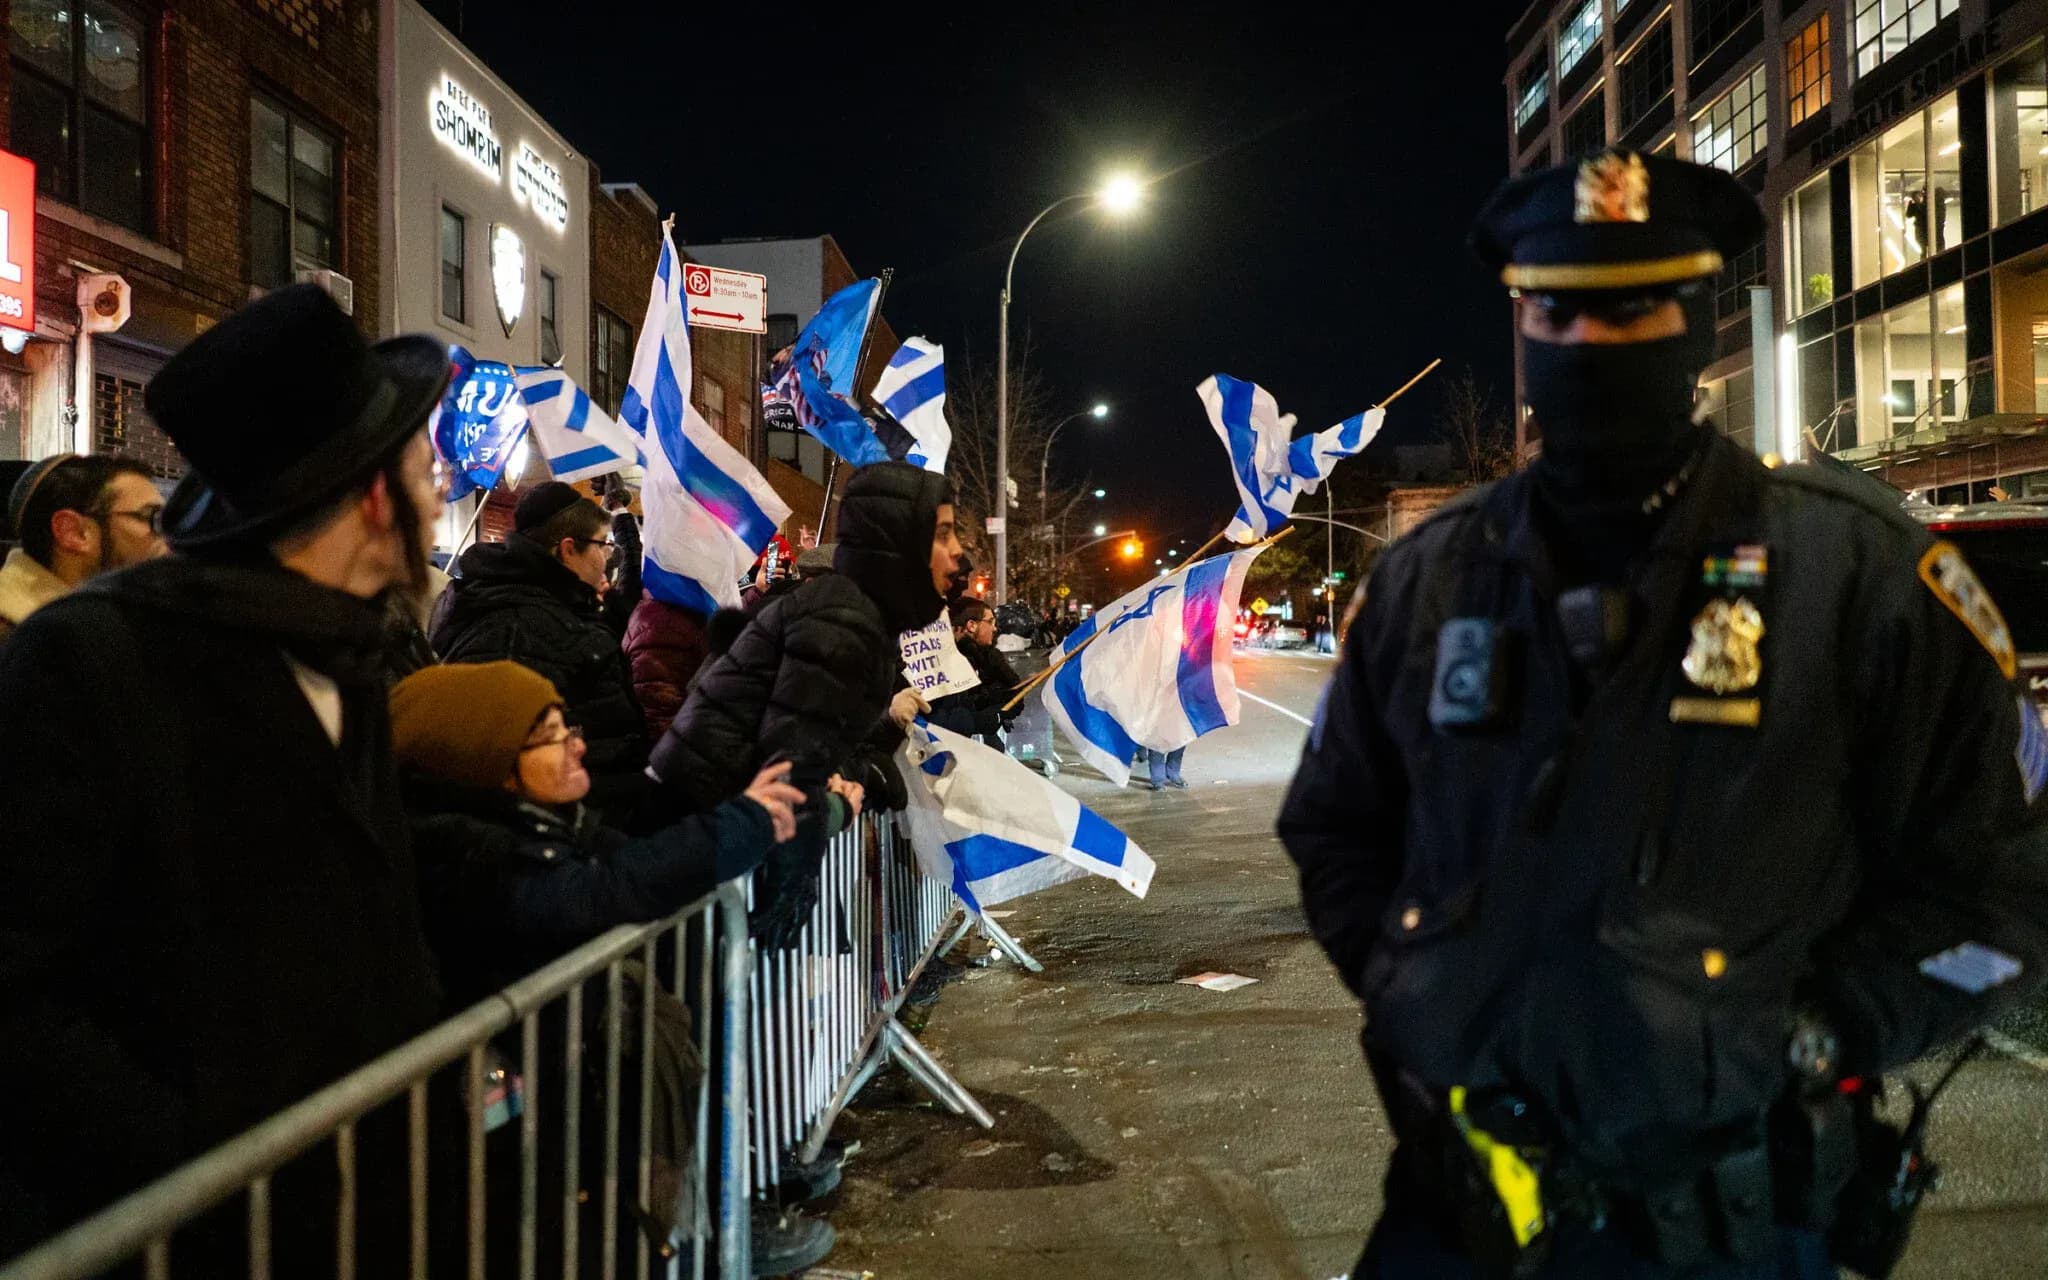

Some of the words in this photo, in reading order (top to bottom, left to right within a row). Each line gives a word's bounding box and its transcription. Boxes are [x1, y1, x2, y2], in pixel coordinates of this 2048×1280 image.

[436, 99, 502, 177] SHOMRIM
[713, 276, 747, 288] Wednesday
[908, 654, 941, 673] WIT
